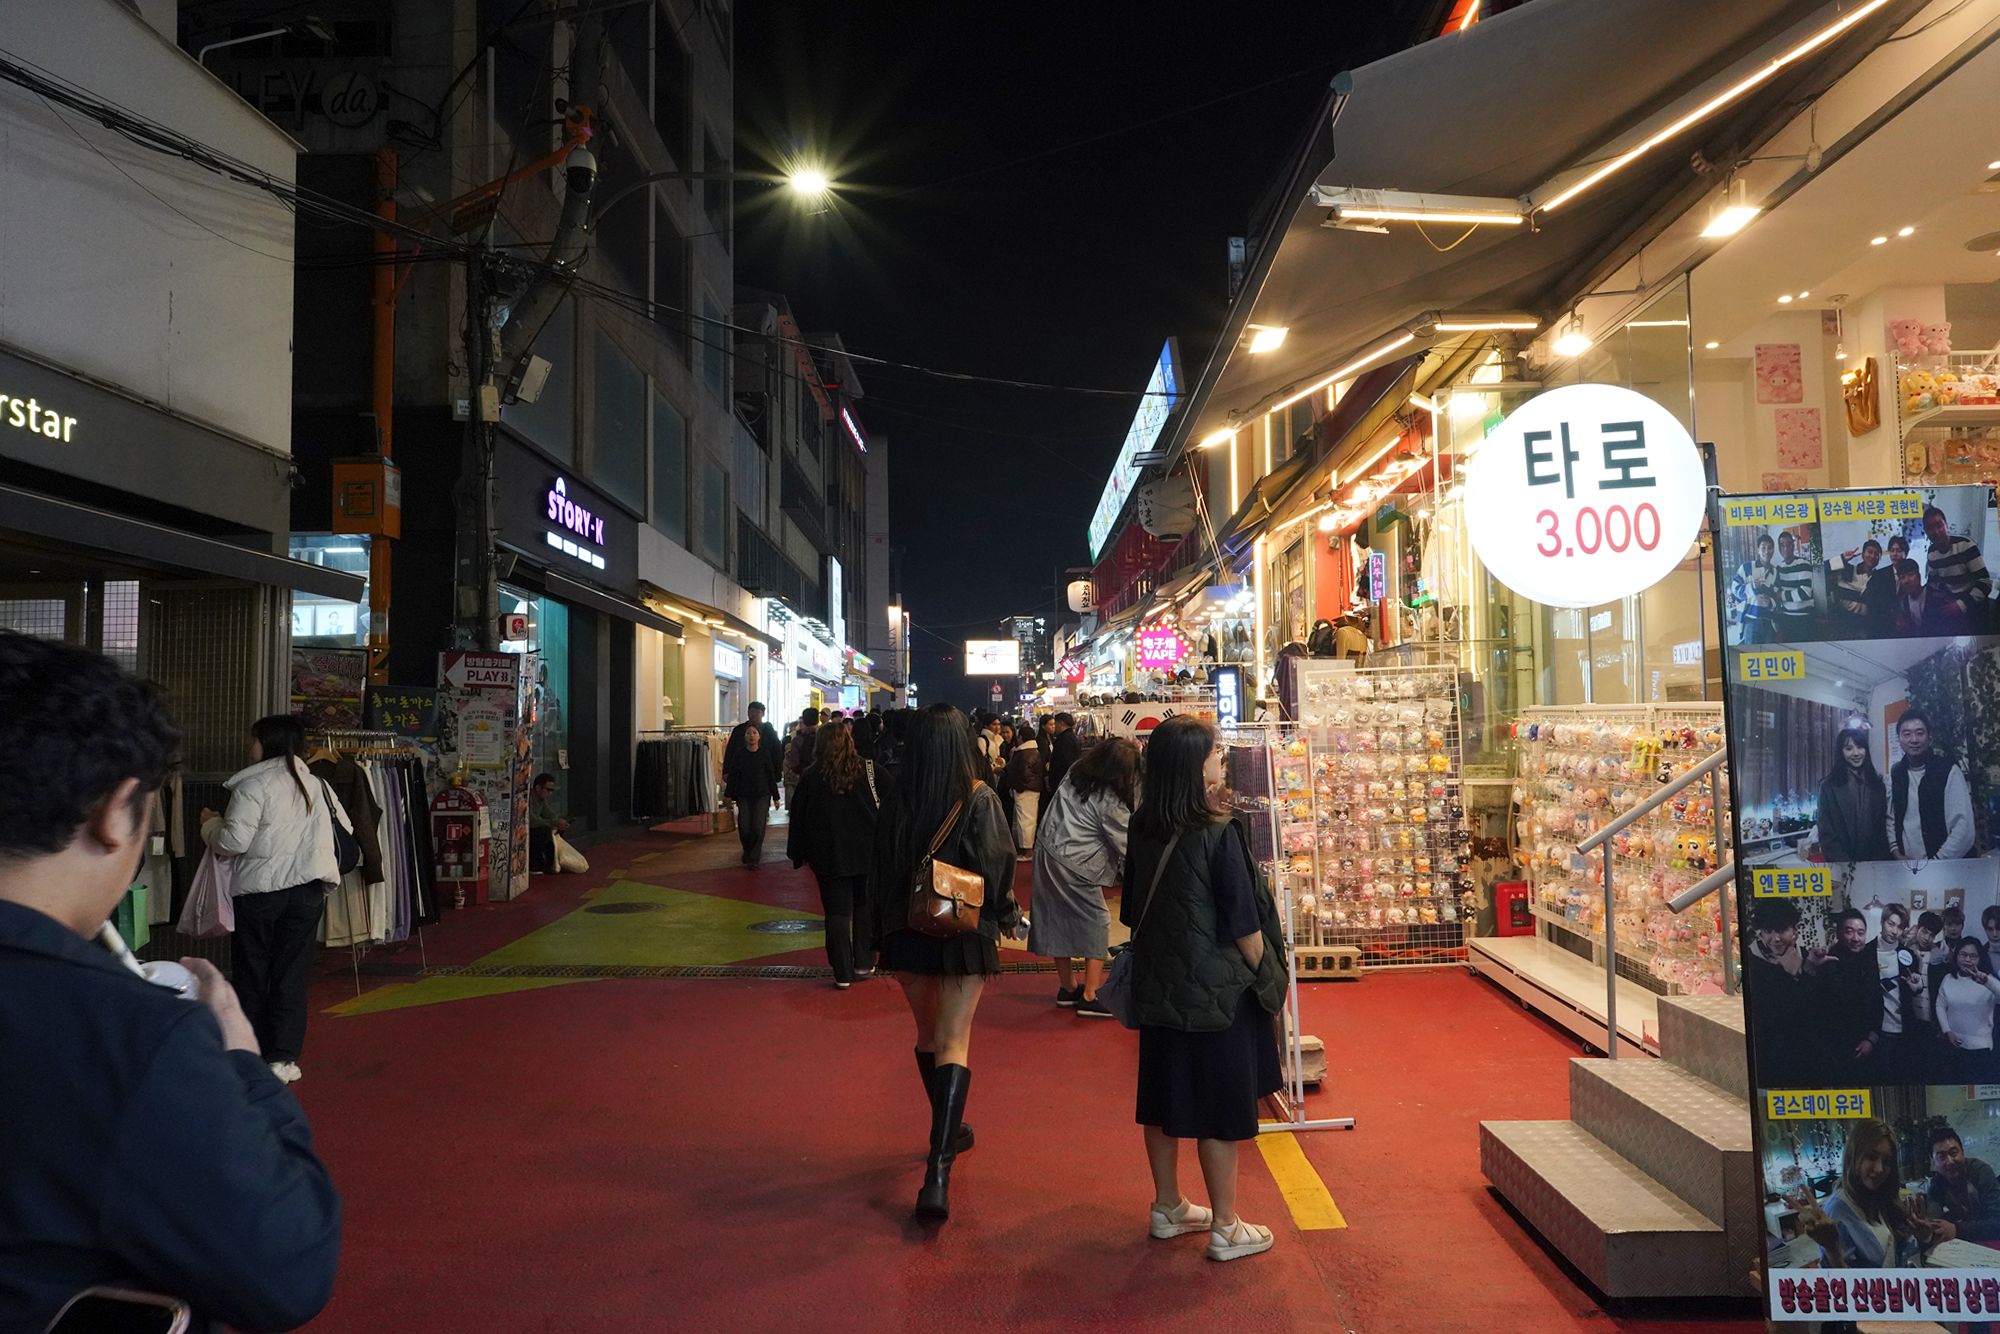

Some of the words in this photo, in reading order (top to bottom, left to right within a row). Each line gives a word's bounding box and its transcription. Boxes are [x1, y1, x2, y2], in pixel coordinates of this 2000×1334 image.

[1523, 420, 1657, 499] 타로
[548, 490, 604, 545] STORY-K
[1730, 505, 1767, 521] 비투비
[1772, 503, 1809, 519] 서은광
[1823, 500, 1852, 516] 장수원
[1856, 499, 1885, 515] 서은광
[1889, 499, 1919, 515] 권현빈
[1535, 502, 1661, 558] 3.000
[1143, 650, 1177, 660] VAPE
[1747, 656, 1797, 677] 김민아
[1759, 872, 1824, 893] 엔플라잉
[1772, 1094, 1830, 1116] 걸스데이
[1834, 1093, 1864, 1115] 유라
[1778, 1277, 1848, 1314] 방송출연
[1851, 1277, 1921, 1314] 선생님이
[1924, 1277, 1961, 1314] 직접
